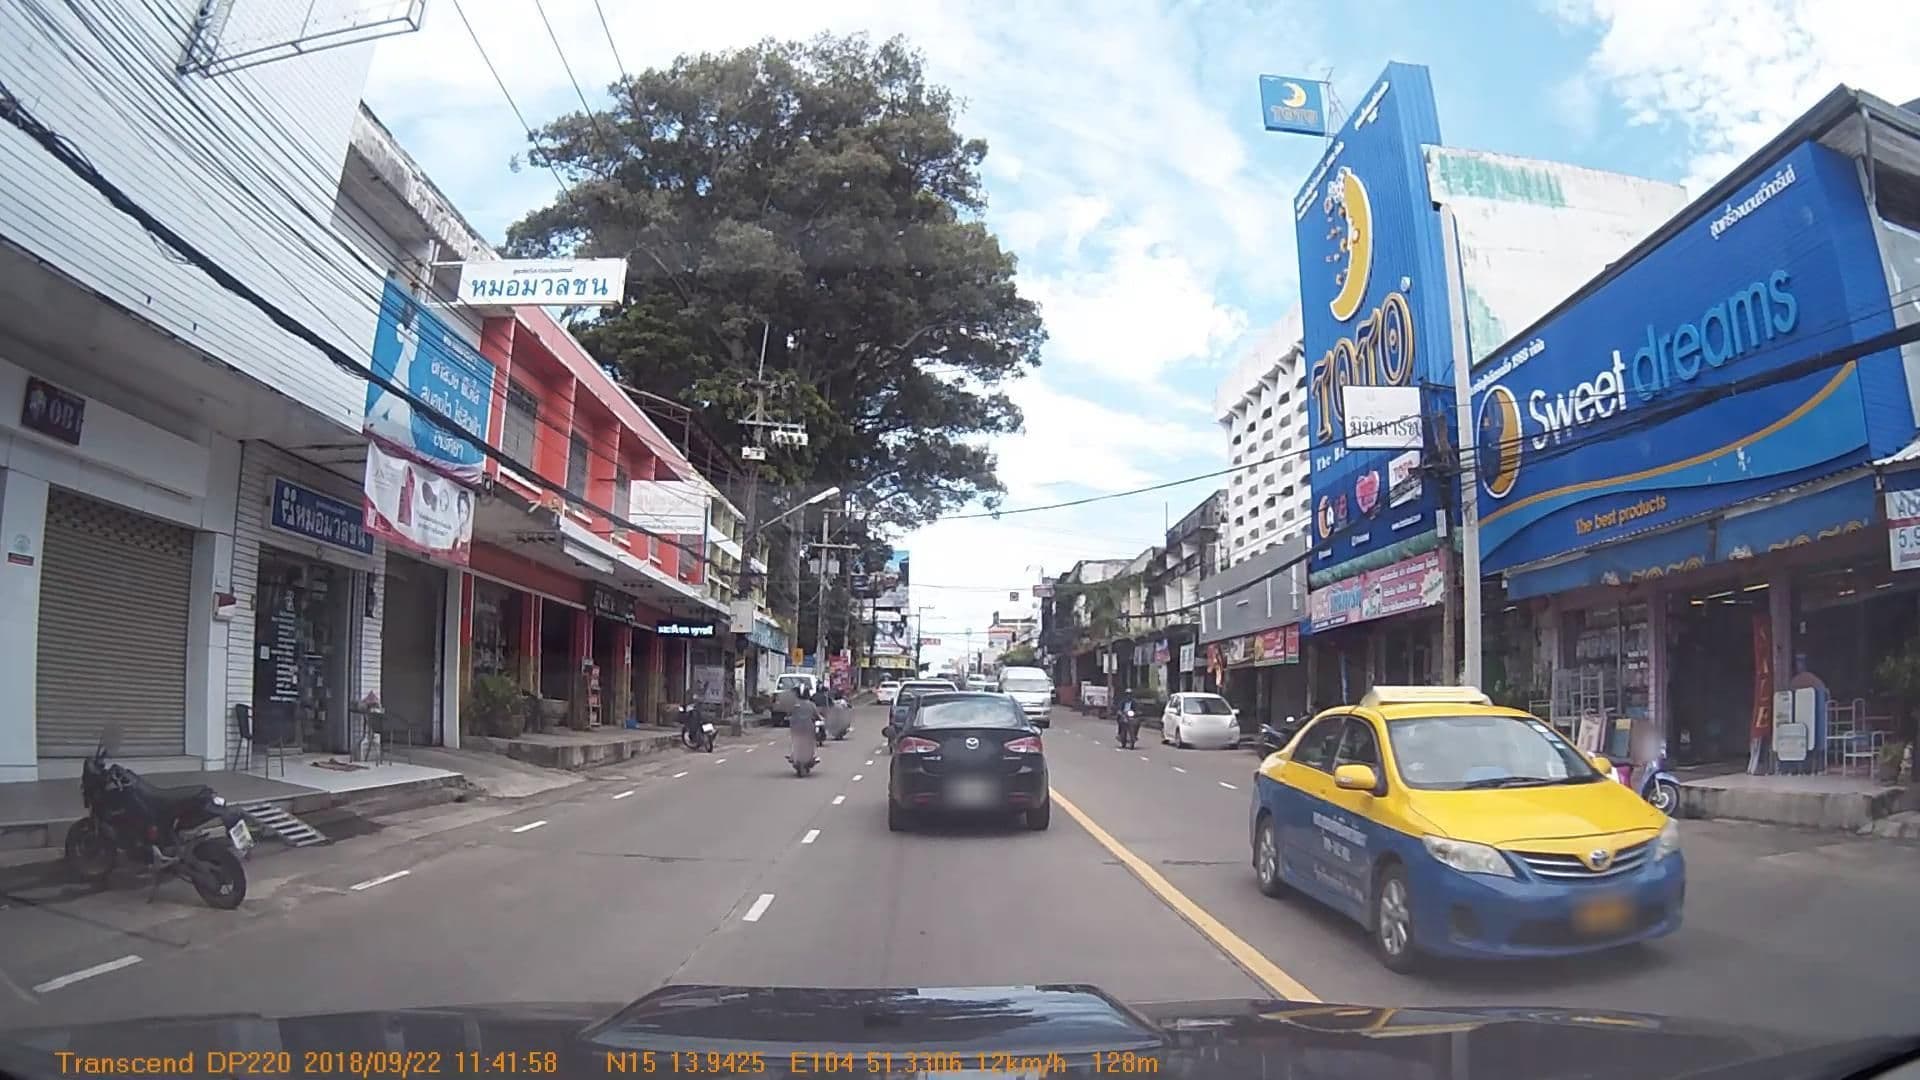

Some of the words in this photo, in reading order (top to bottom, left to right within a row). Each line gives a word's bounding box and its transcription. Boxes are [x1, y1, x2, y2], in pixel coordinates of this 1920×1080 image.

[472, 277, 608, 297] หมอมวลชน
[1528, 350, 1628, 450] Sweet
[1633, 269, 1797, 396] dreams
[1594, 508, 1617, 530] best
[1618, 495, 1668, 529] products
